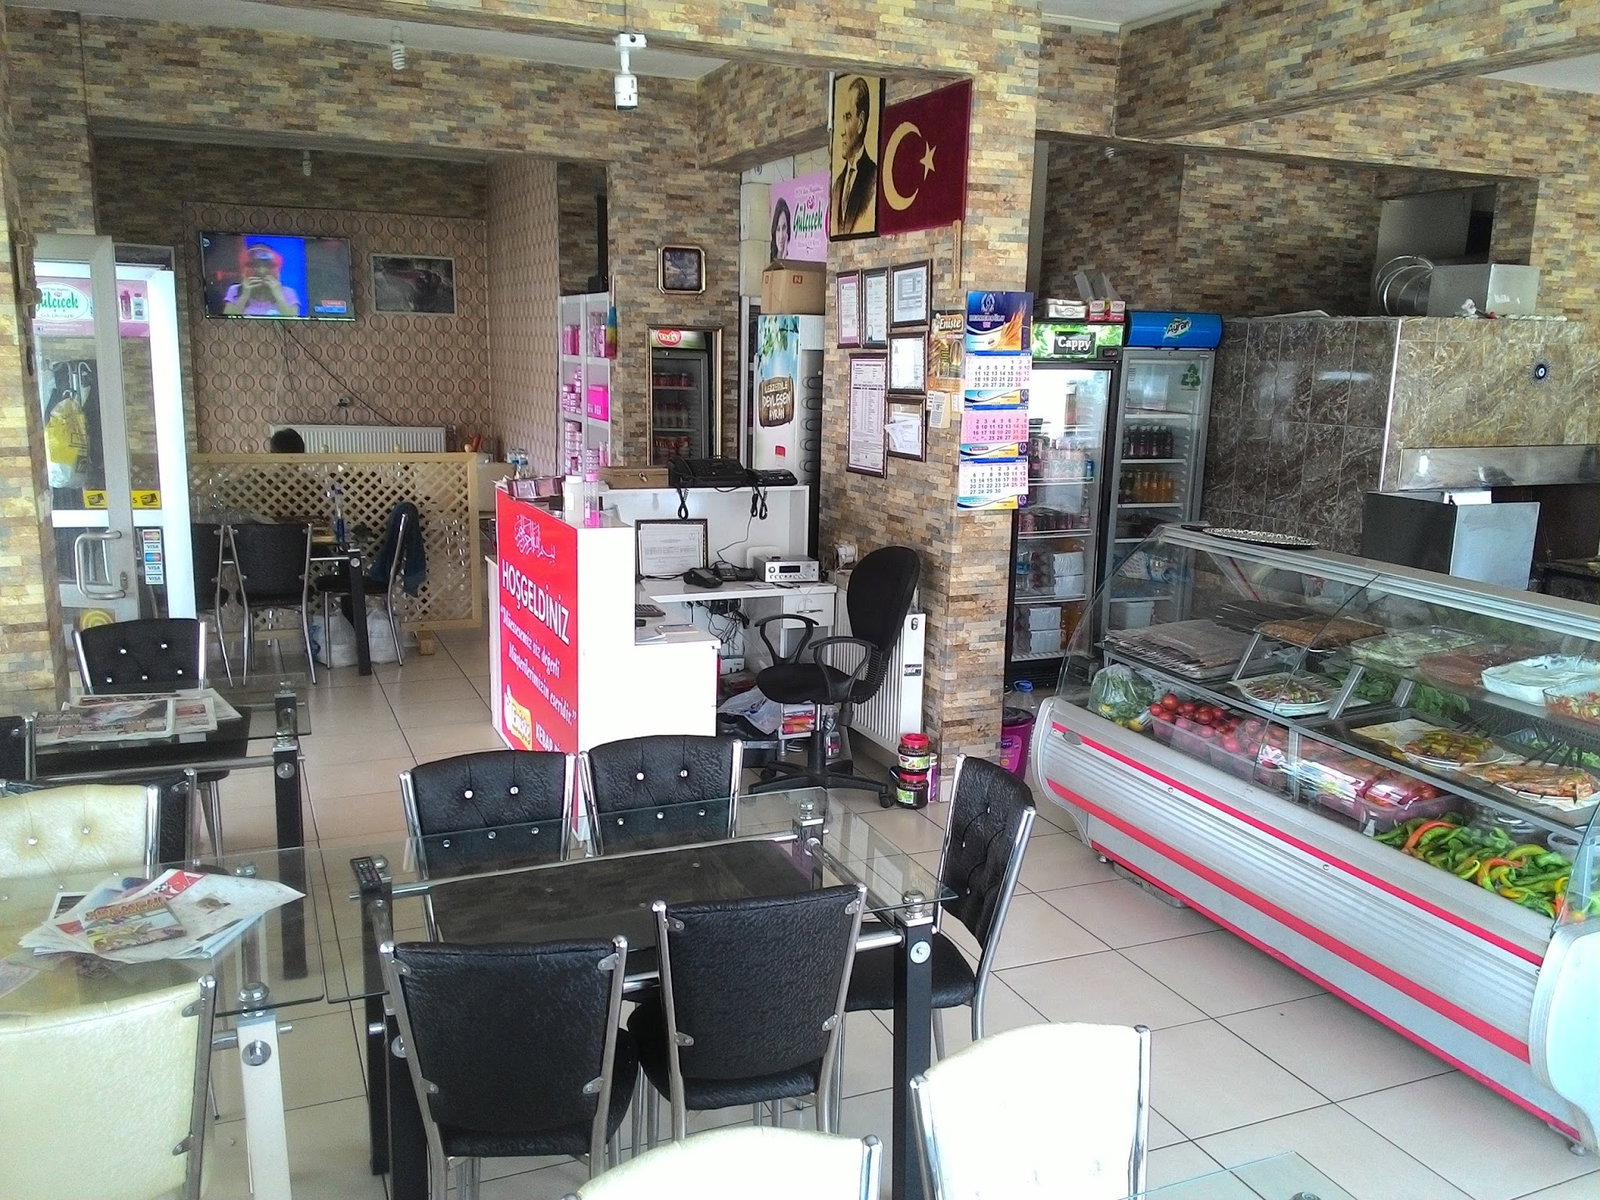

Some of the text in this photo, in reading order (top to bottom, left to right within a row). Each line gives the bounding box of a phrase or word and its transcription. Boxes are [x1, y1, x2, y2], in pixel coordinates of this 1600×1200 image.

[36, 291, 79, 312] ülçiçek
[1057, 336, 1092, 351] Cappy
[502, 558, 571, 647] HOŞGELDİNİZ
